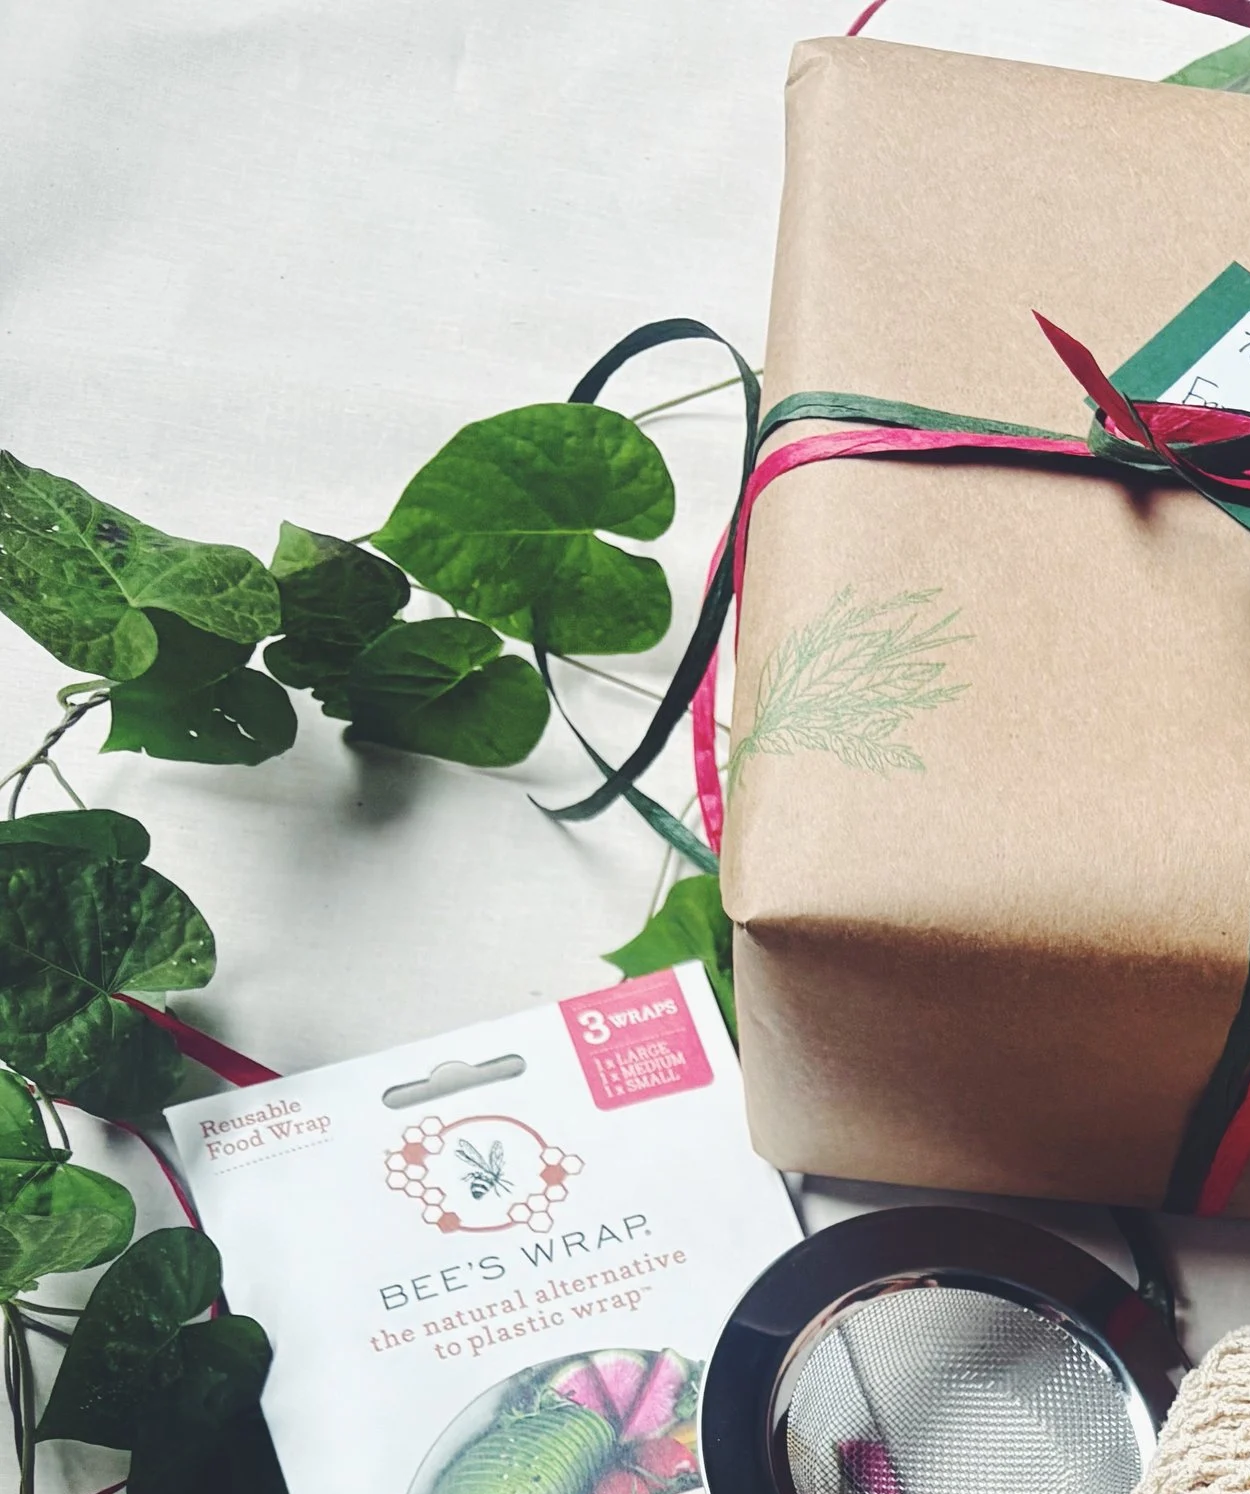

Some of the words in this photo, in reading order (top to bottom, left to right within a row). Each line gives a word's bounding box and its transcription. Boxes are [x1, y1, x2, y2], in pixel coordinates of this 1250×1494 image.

[577, 1009, 611, 1044] 3
[608, 999, 678, 1028] WRAPS
[616, 1041, 671, 1065] LARGE
[620, 1052, 686, 1080] MEDIUM
[626, 1070, 681, 1092] SMALL
[199, 1099, 302, 1138] Reusable
[206, 1129, 265, 1161] Food
[268, 1114, 331, 1141] Wrap
[370, 1328, 416, 1353] the
[423, 1290, 528, 1337] natural
[535, 1250, 687, 1304] alternative
[380, 1256, 506, 1310] BEE'S
[434, 1341, 462, 1360] to
[467, 1310, 565, 1357] plastic
